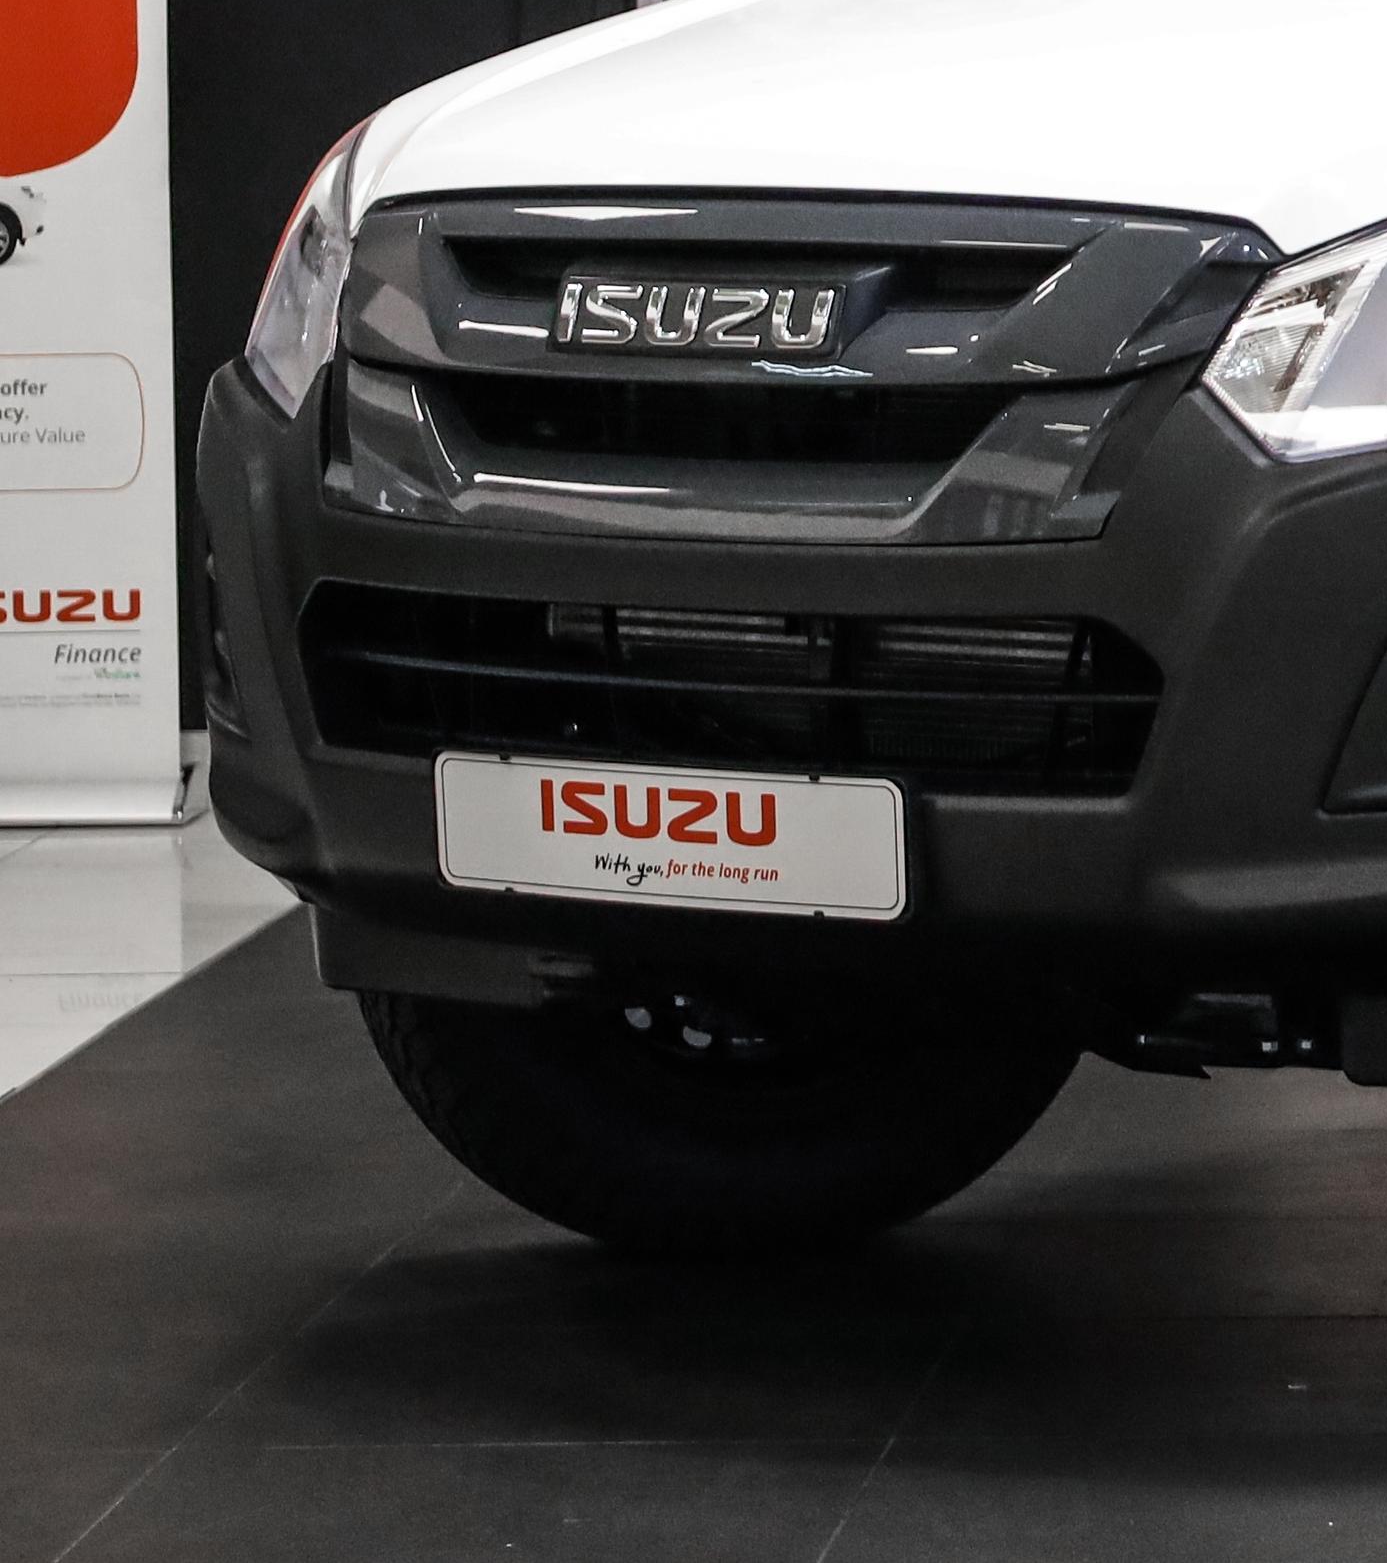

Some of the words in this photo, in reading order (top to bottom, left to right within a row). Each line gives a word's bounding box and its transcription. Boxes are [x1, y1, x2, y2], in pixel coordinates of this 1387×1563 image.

[558, 283, 834, 348] ISUZU
[0, 379, 47, 396] offer
[35, 427, 86, 444] Value
[0, 589, 141, 623] UZU
[54, 643, 142, 664] Finance
[540, 779, 776, 847] ISUZU
[595, 853, 631, 874] With
[626, 863, 663, 886] you,
[666, 859, 688, 878] for
[692, 861, 714, 877] the
[719, 863, 749, 884] long
[754, 868, 779, 881] run
